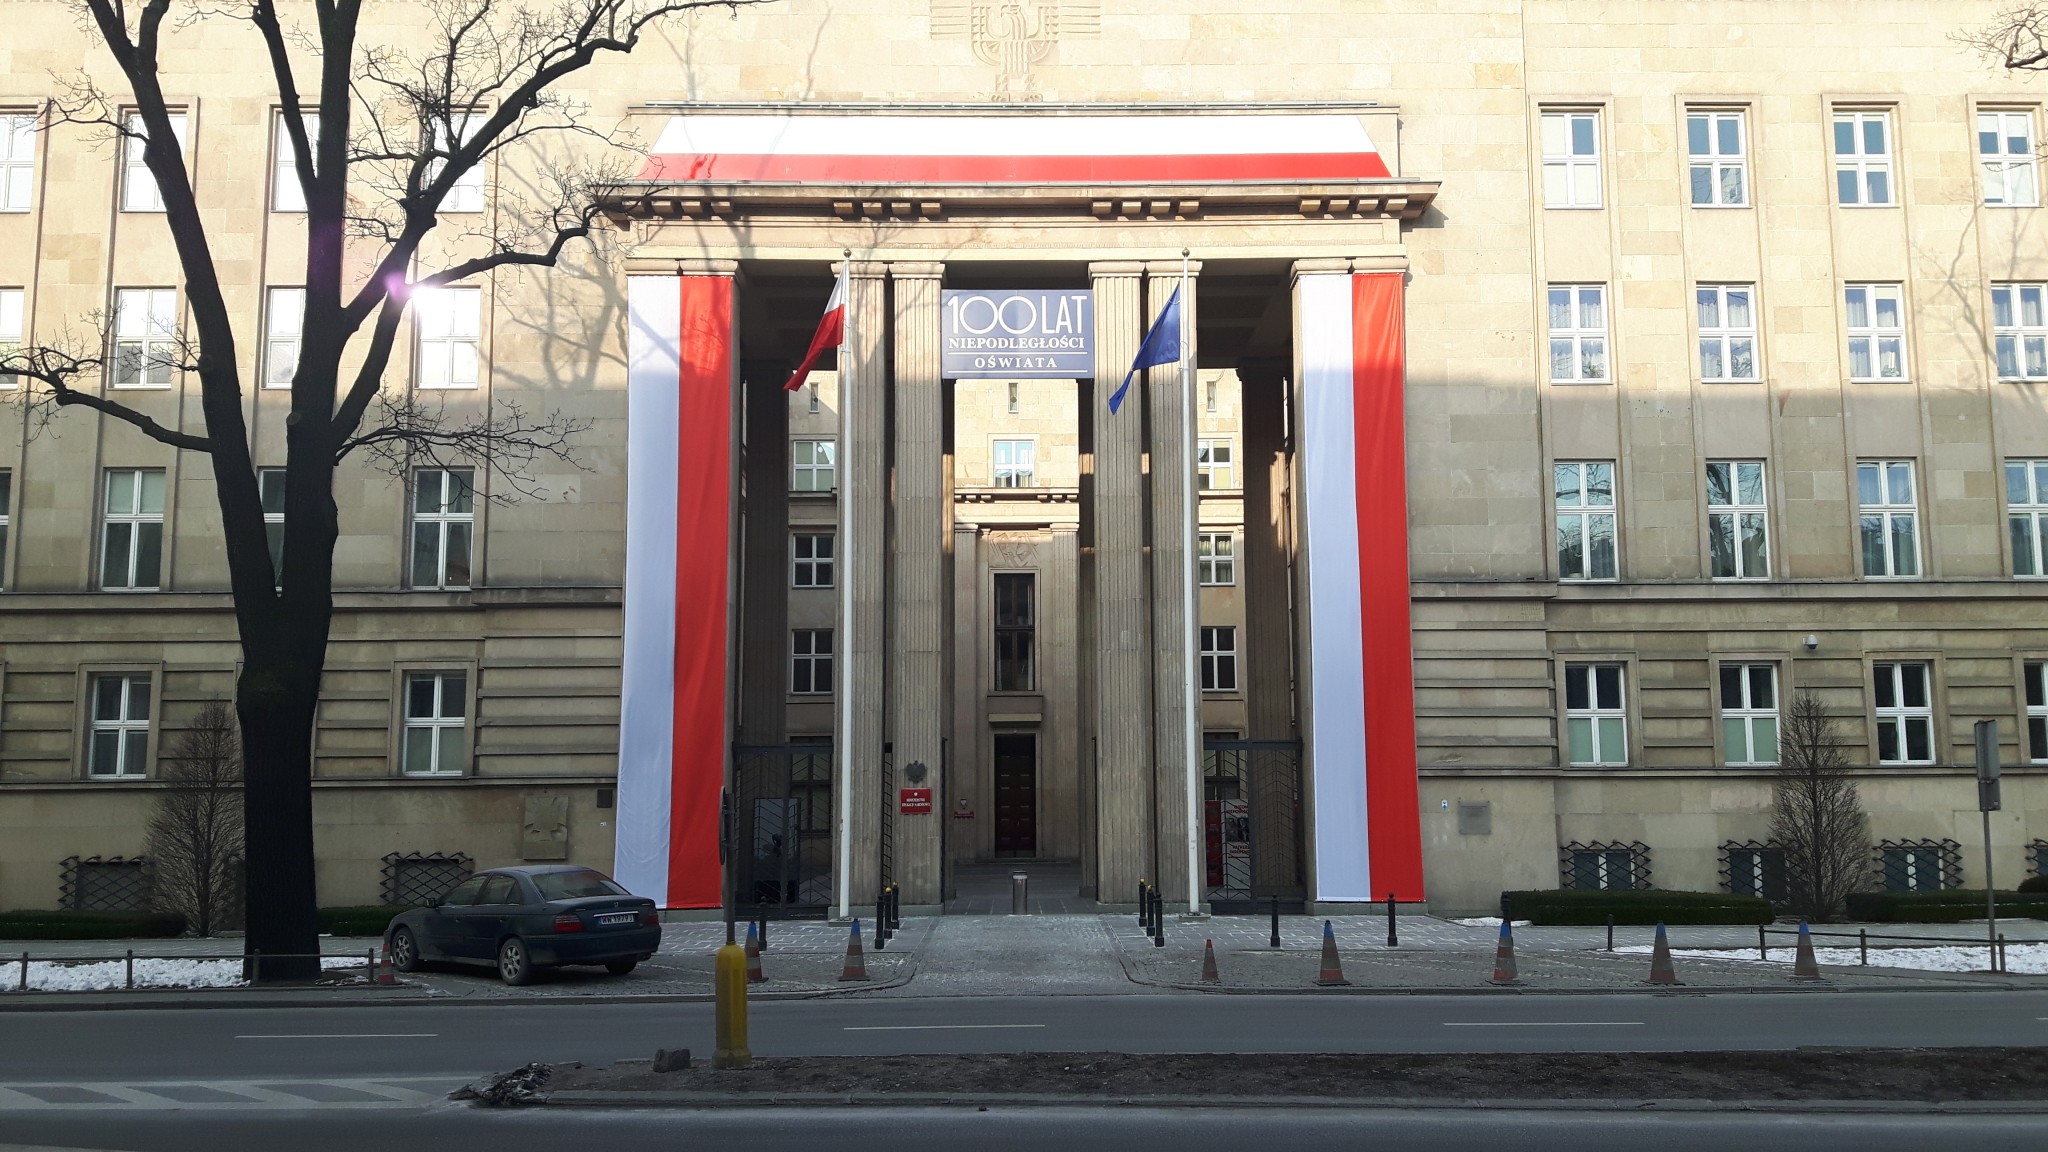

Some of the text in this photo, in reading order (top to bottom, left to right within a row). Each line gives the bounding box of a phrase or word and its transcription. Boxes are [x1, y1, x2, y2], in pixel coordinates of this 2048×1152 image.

[947, 295, 1088, 335] 100 LAT
[948, 335, 1085, 349] NIEPODLEGŁOŚCI
[974, 355, 1057, 369] OŚWIATA
